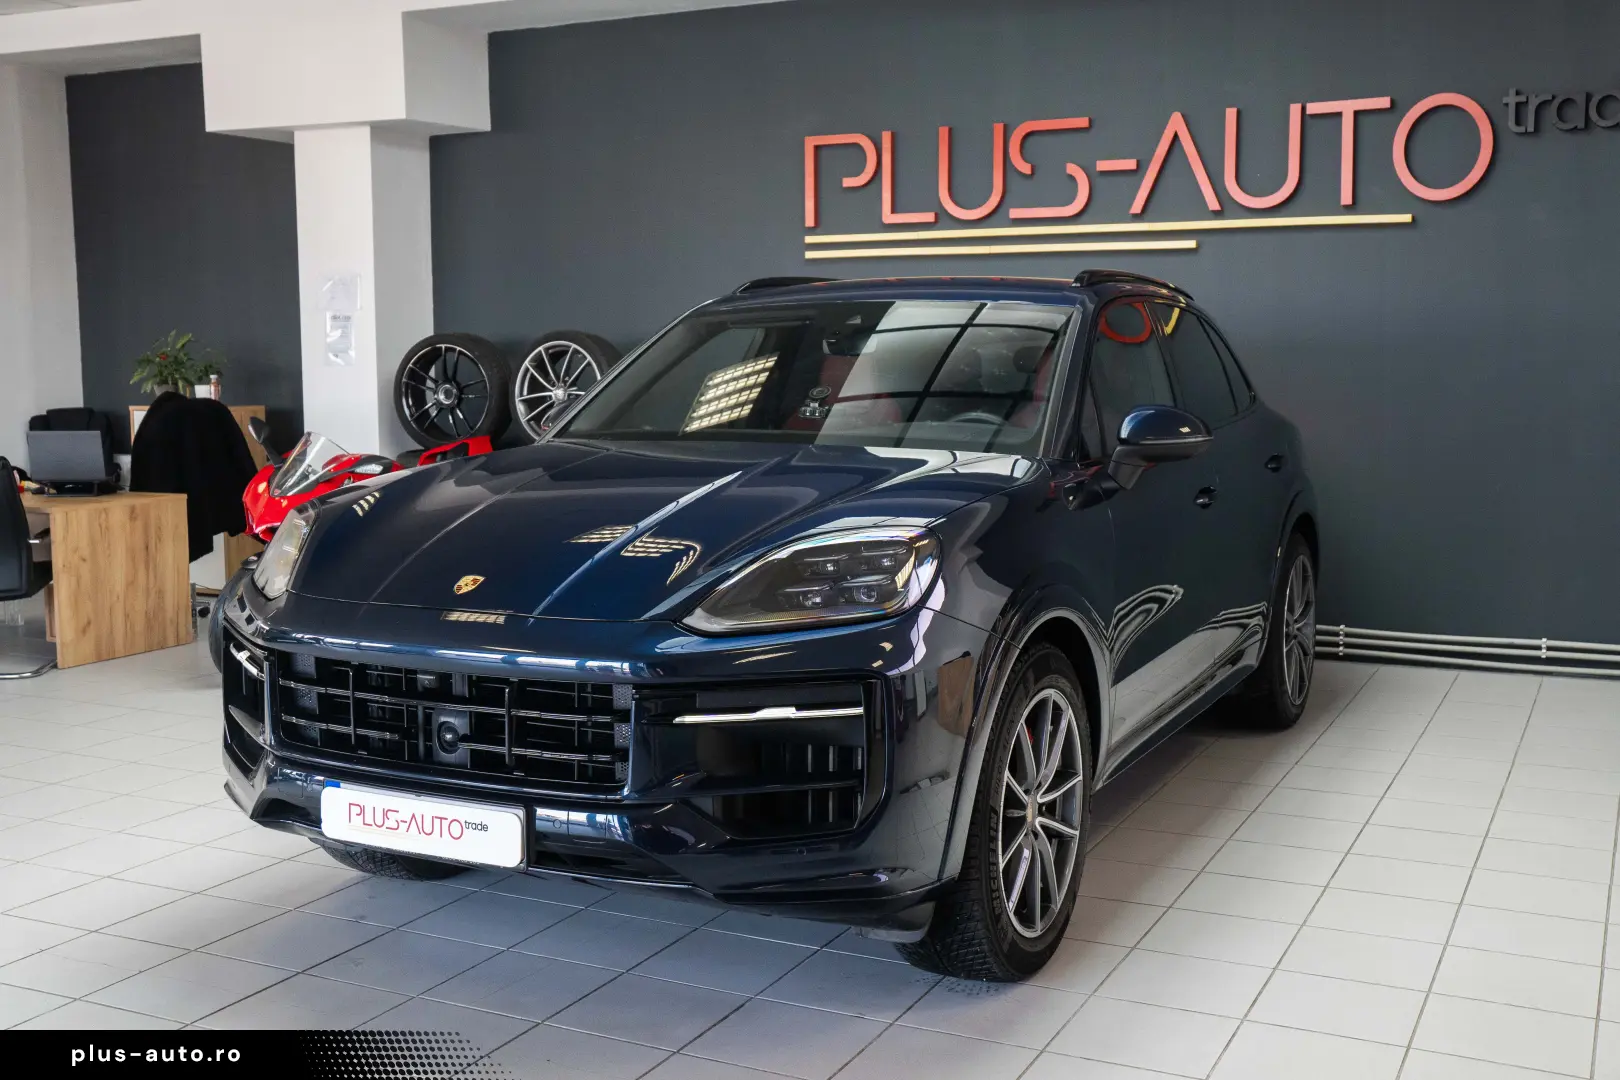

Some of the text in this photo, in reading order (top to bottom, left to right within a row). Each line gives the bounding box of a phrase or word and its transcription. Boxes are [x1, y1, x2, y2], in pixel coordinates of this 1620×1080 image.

[804, 92, 1494, 228] PLUS-AUTO
[348, 802, 489, 841] PLUS-AUTO trade
[989, 811, 1002, 915] MICHELIN
